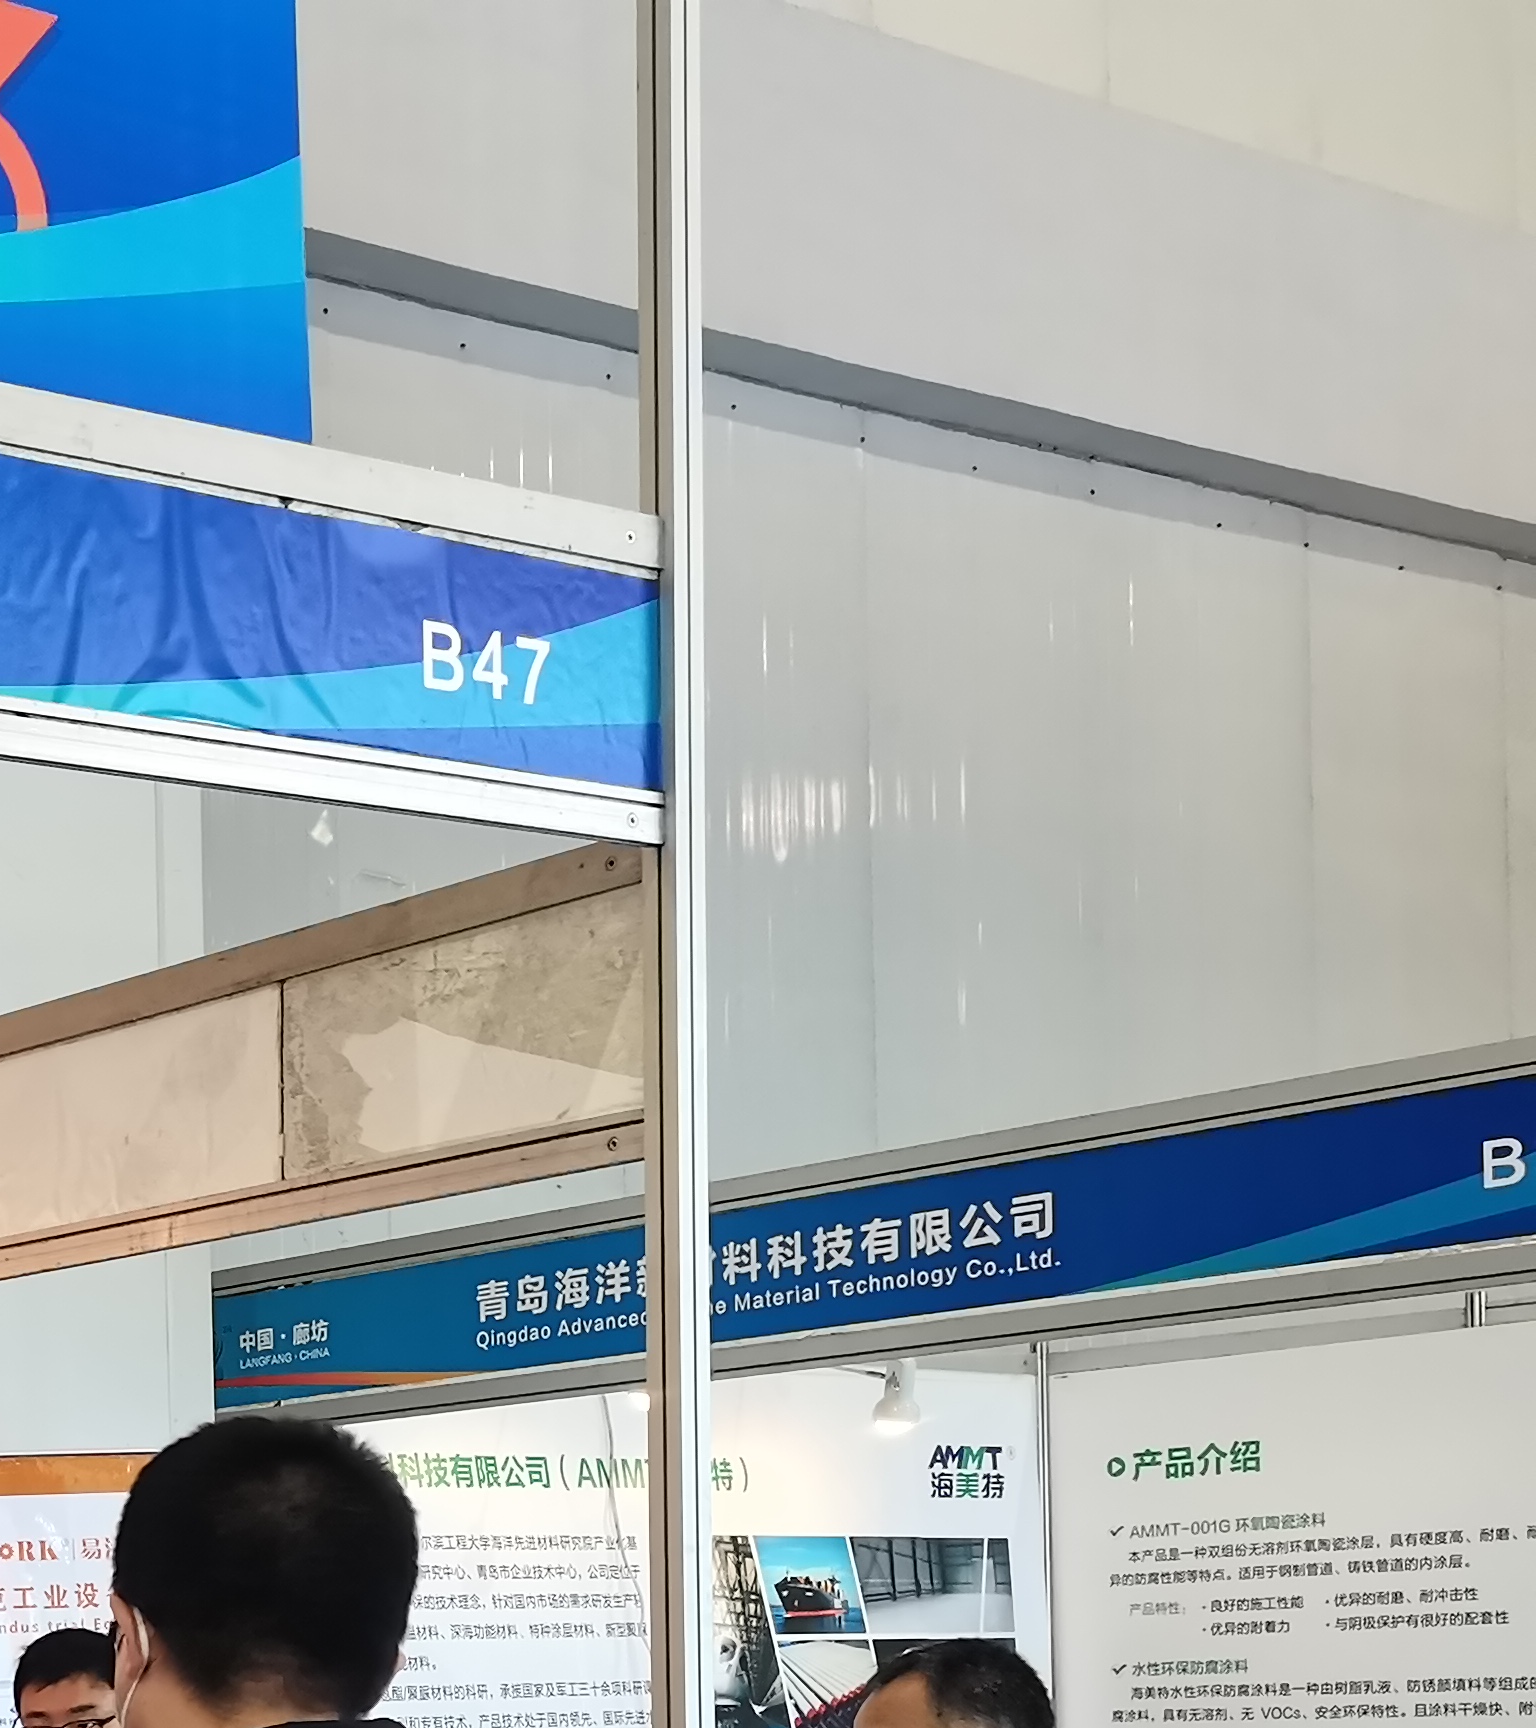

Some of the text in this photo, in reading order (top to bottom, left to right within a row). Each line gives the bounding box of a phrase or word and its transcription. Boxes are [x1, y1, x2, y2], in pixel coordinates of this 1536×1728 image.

[421, 618, 551, 707] B47
[476, 1322, 552, 1351] Qingdao
[734, 1284, 820, 1312] Material
[827, 1267, 957, 1301] Technology
[239, 1347, 330, 1370] LANGFANG CHINA
[929, 1445, 1004, 1471] AMMT
[1132, 1440, 1261, 1482] 产品介绍
[930, 1472, 1006, 1500] 海美特
[1129, 1512, 1325, 1539] AMMT-001G 环氧陶瓷涂料
[1210, 1595, 1304, 1612] 良好的施工性能
[1210, 1619, 1291, 1636] 优异的附着力
[1132, 1659, 1248, 1677] 水性环保防腐涂料
